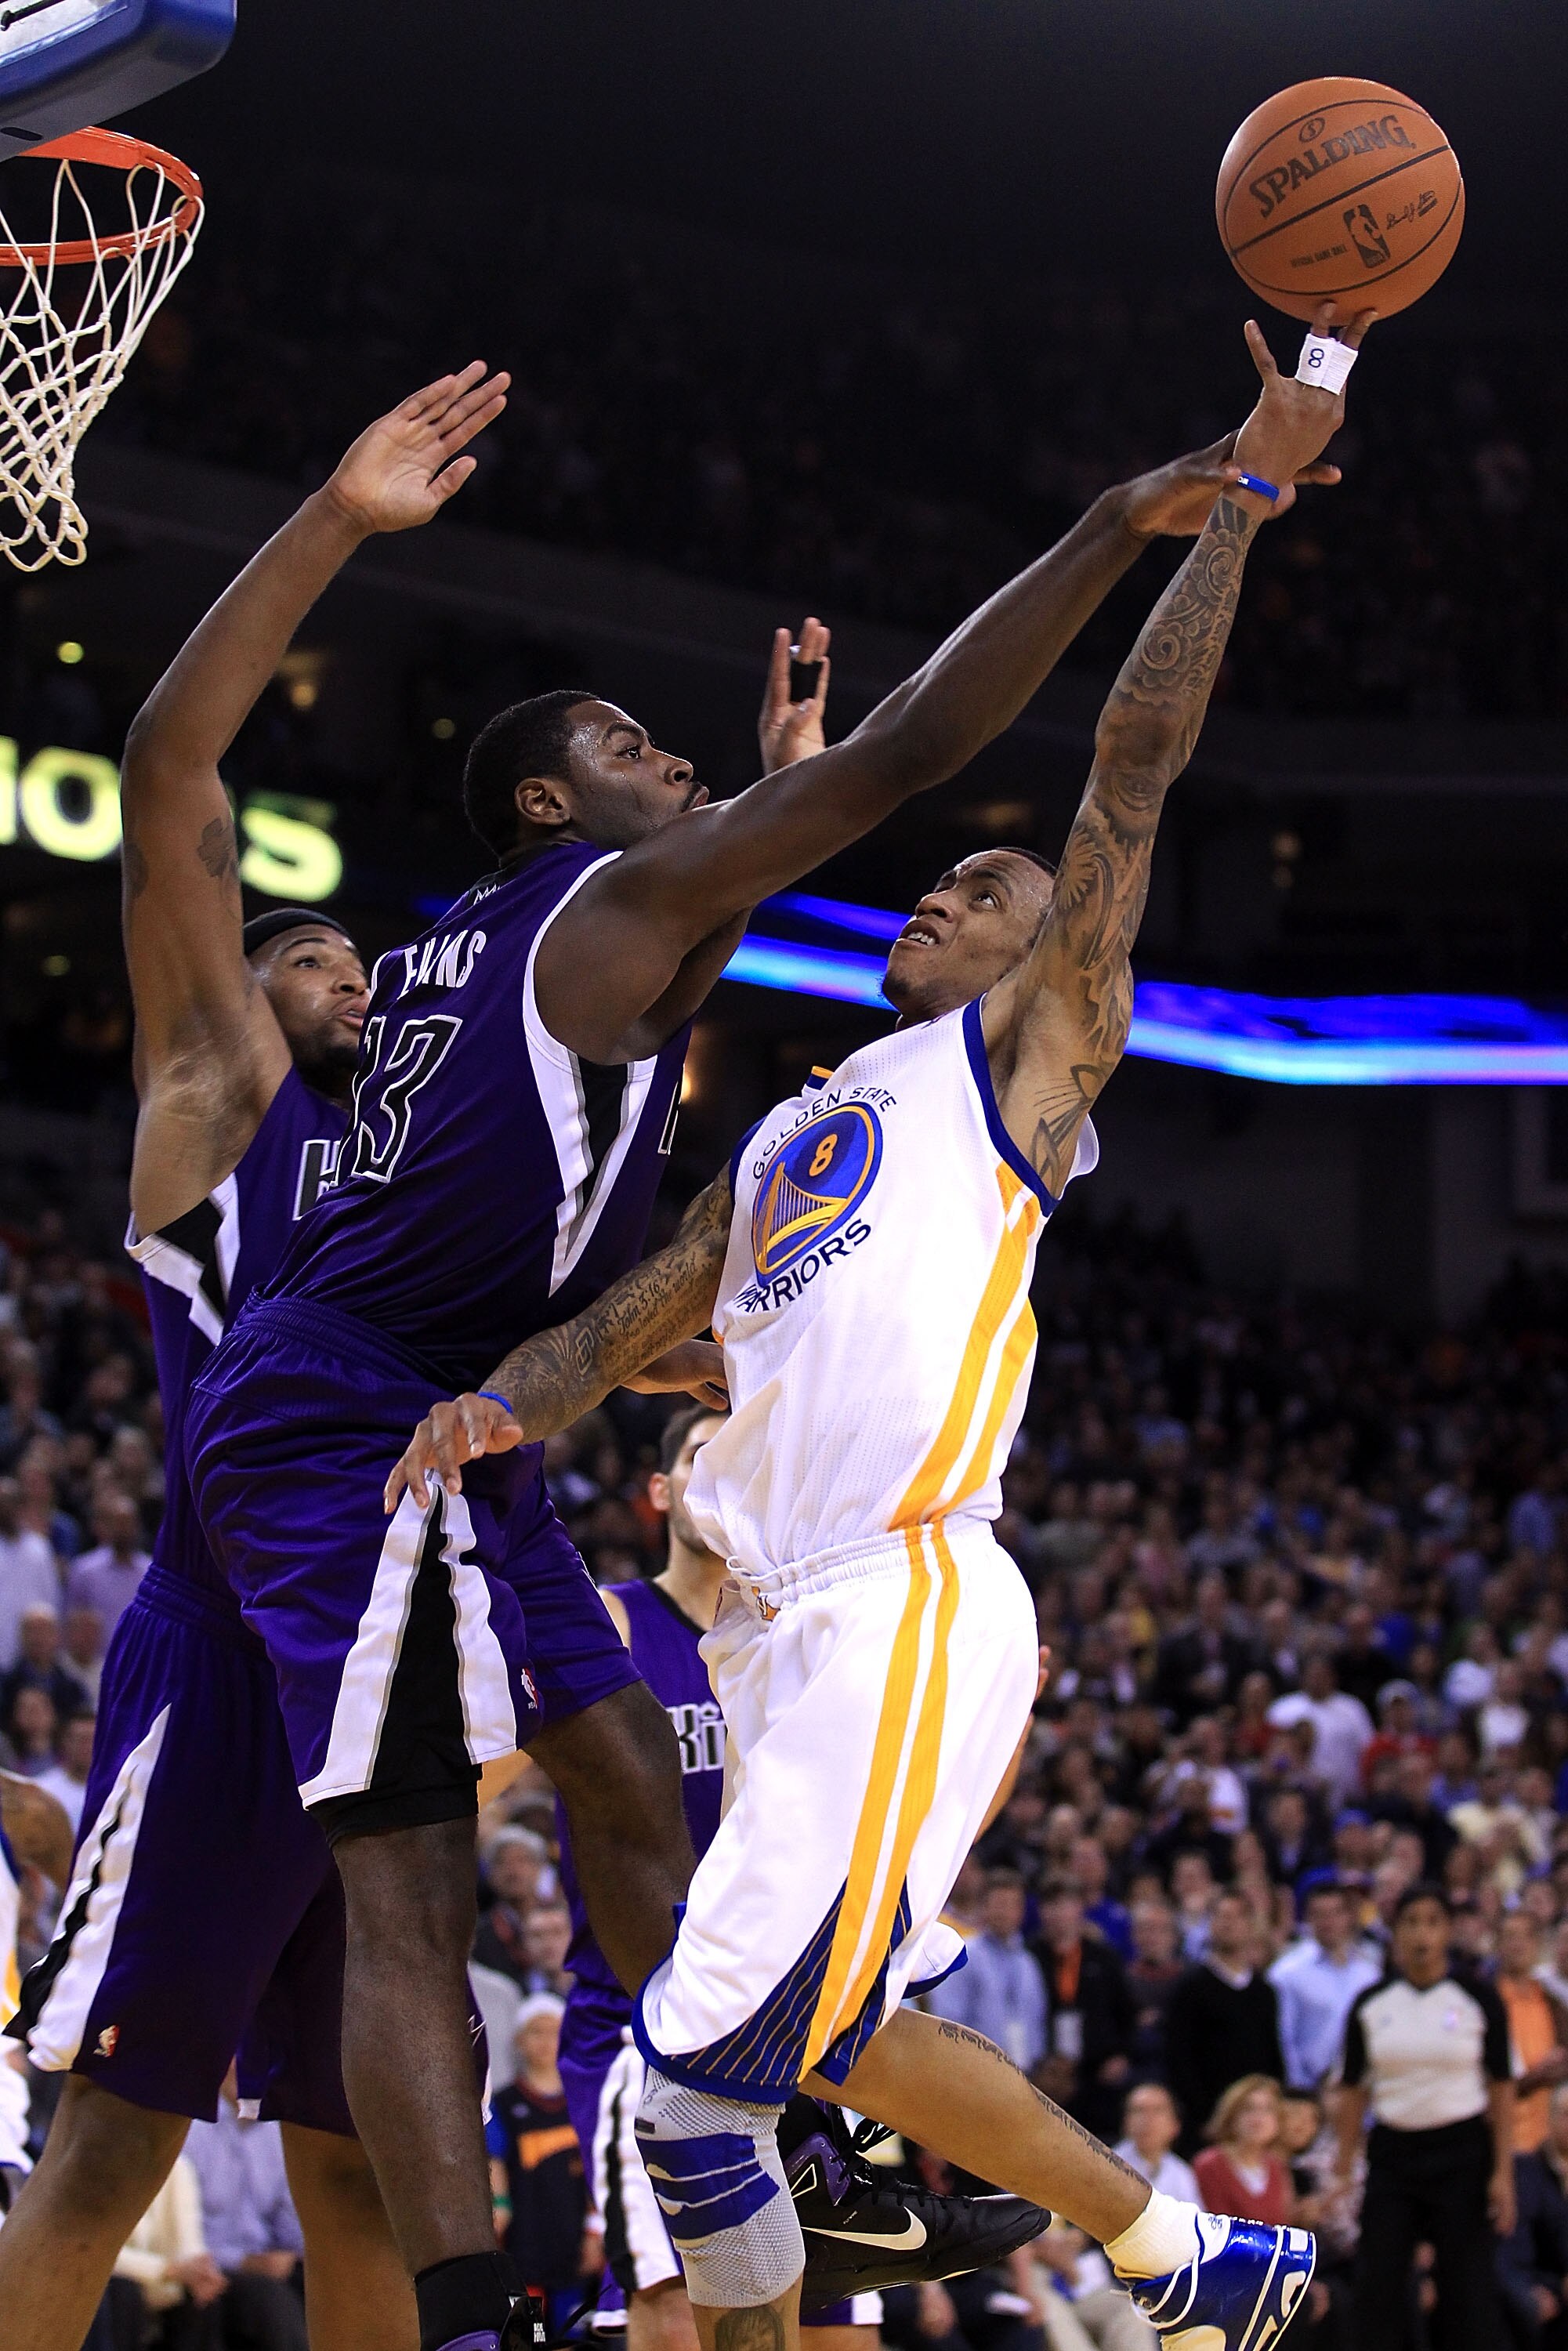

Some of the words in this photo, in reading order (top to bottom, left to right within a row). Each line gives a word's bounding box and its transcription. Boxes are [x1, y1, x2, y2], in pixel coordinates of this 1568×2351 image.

[1248, 114, 1410, 218] SPALDING
[1308, 348, 1324, 368] 8
[752, 1089, 842, 1180] GOLDEN
[849, 1086, 897, 1114] STATE
[809, 1133, 838, 1177] 8
